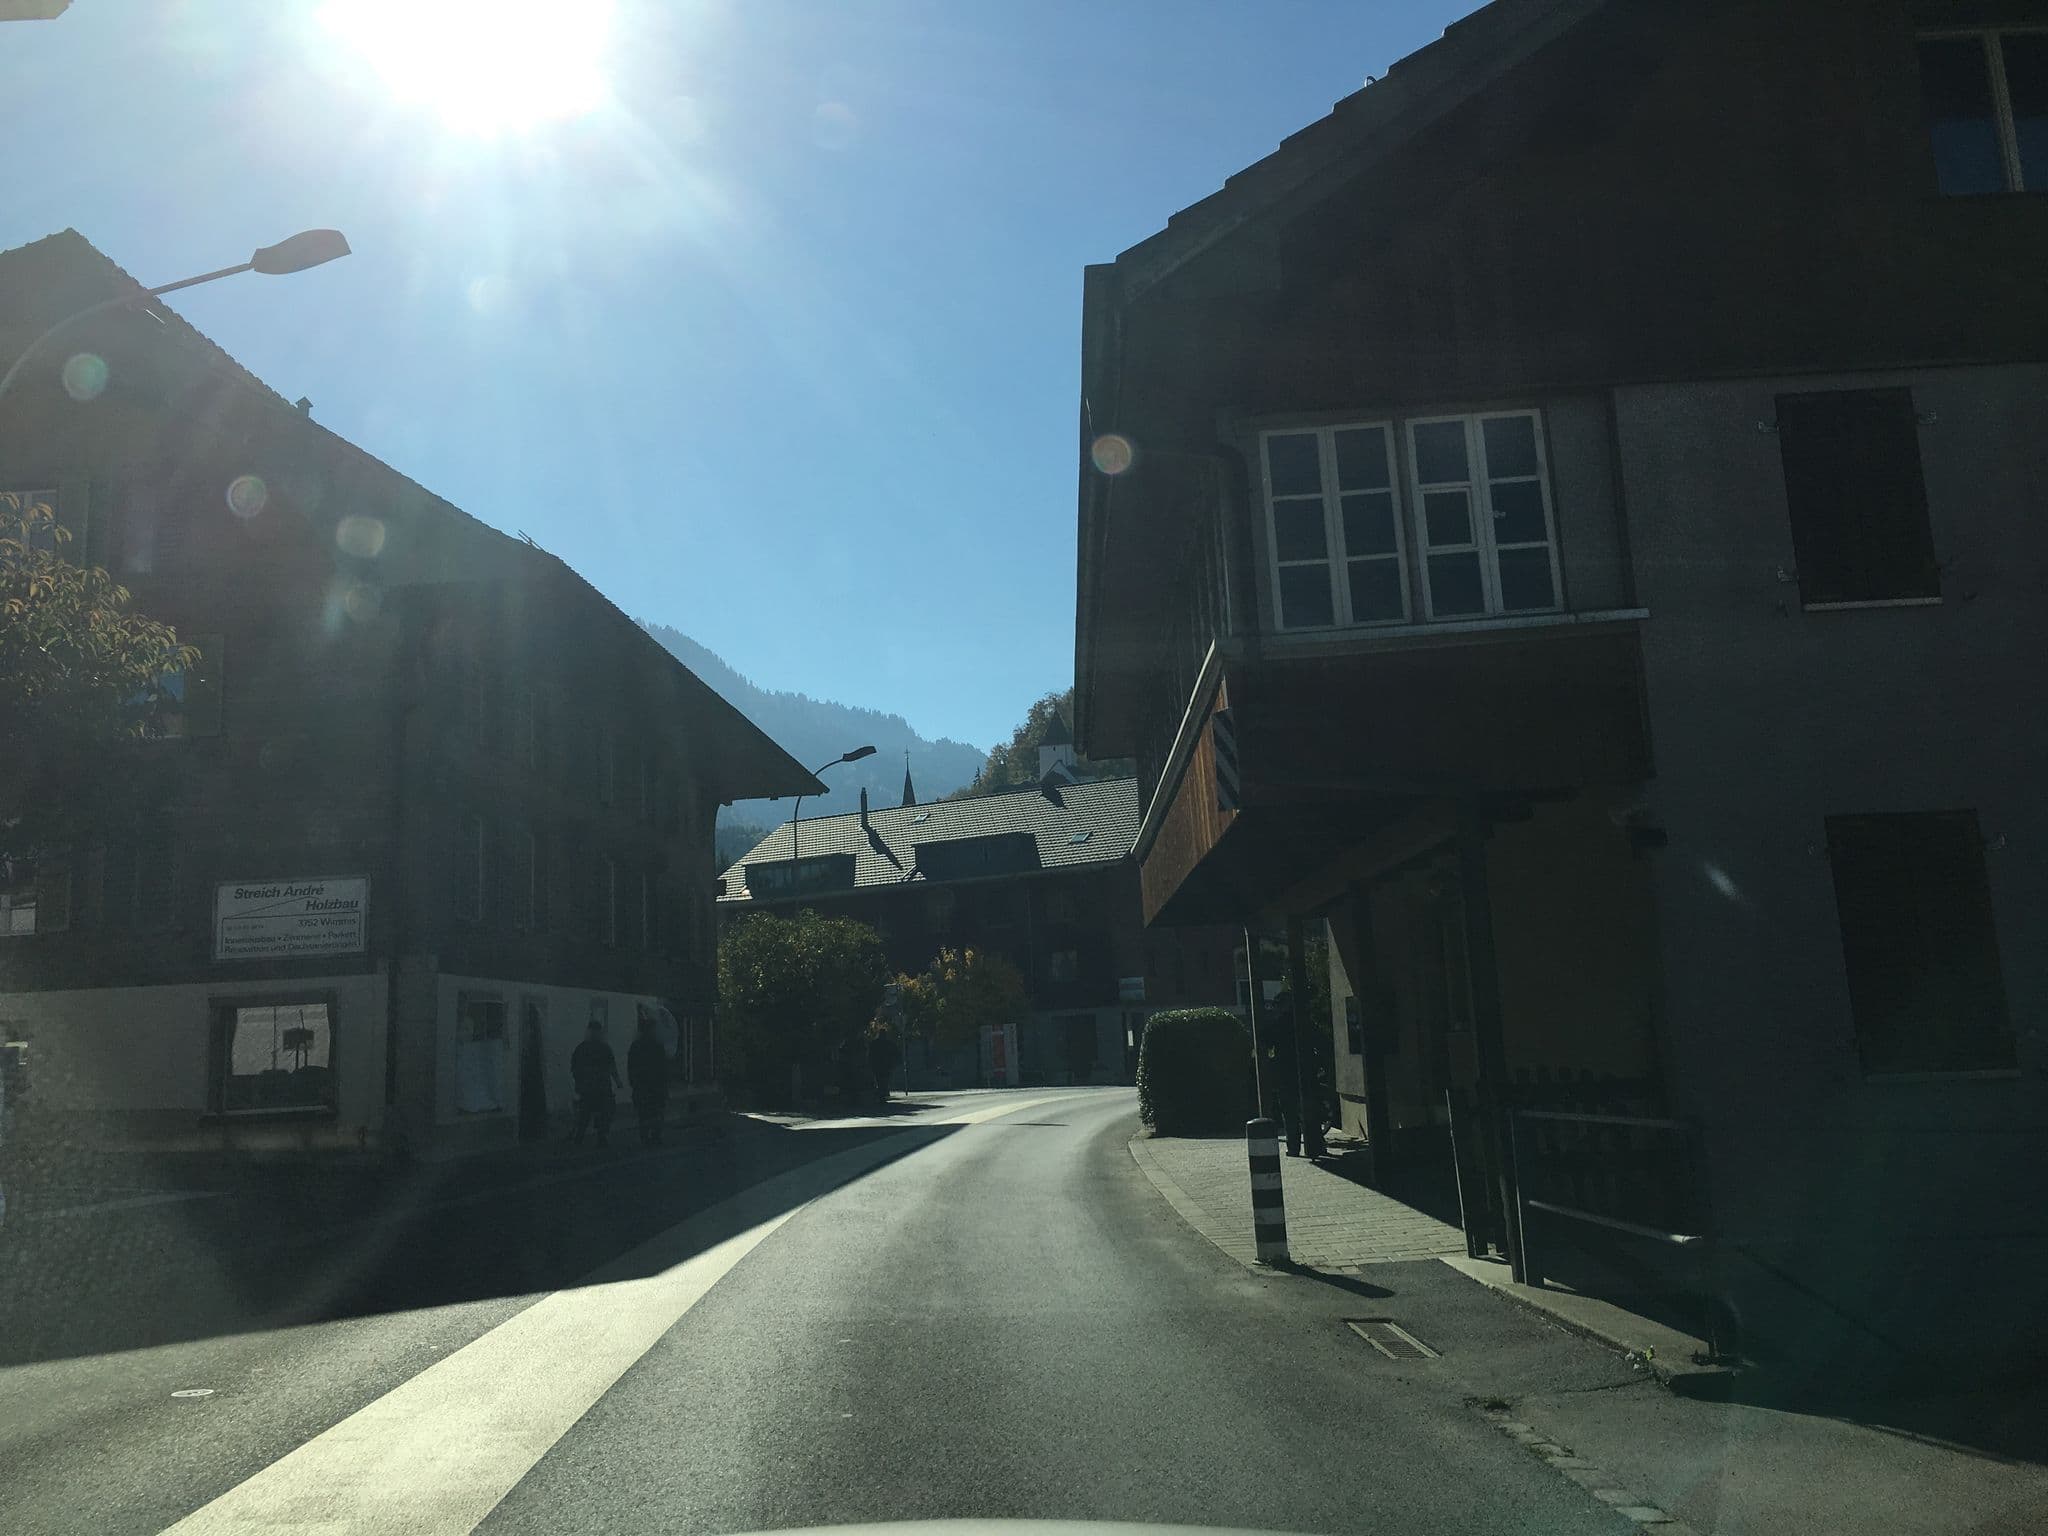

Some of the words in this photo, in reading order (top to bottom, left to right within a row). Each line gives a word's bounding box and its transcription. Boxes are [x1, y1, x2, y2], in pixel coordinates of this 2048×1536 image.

[234, 887, 281, 900] Streich
[283, 885, 325, 897] André
[305, 898, 358, 911] Holzbau
[320, 917, 356, 927] Wimmis
